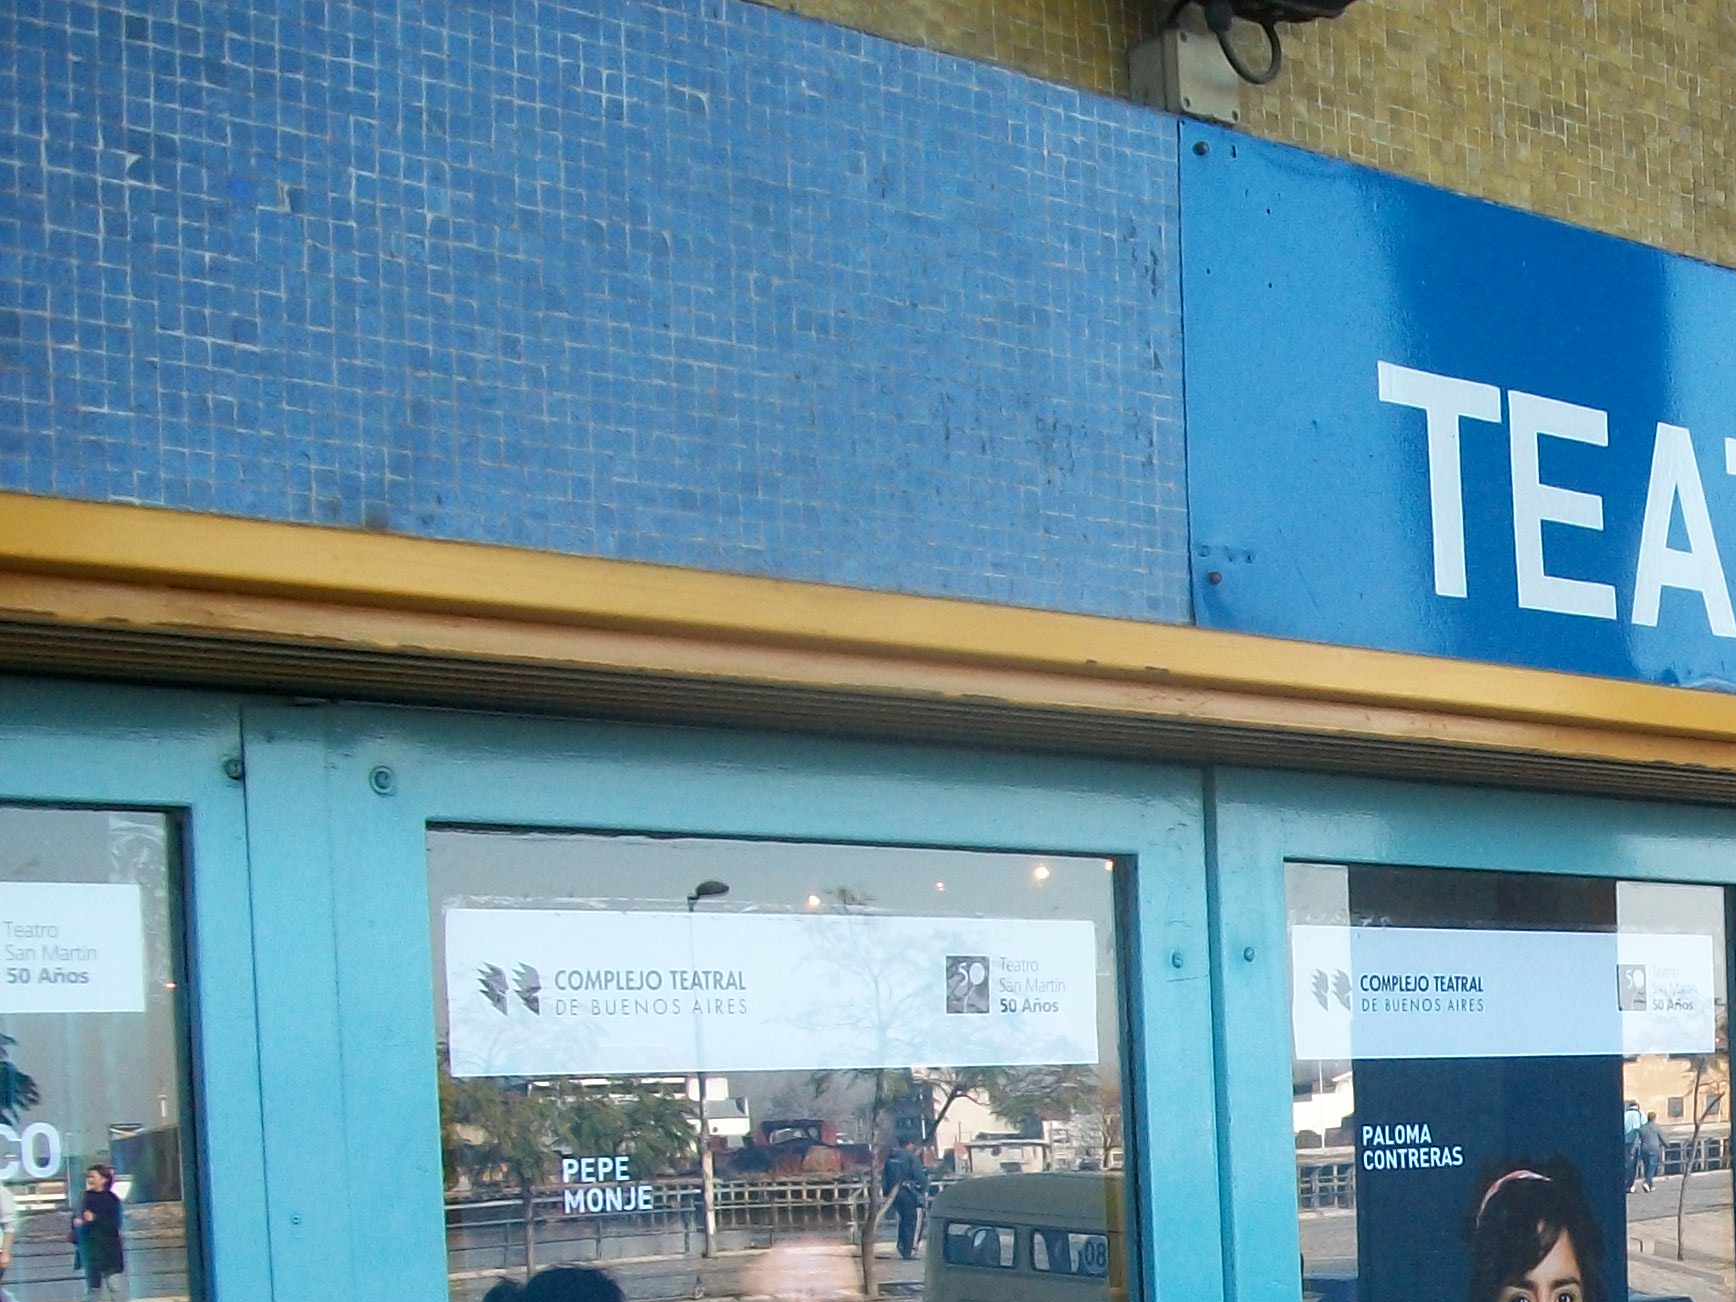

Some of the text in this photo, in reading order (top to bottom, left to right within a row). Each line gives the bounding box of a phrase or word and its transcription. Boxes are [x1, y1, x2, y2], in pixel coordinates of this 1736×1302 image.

[3, 920, 58, 938] Teatro
[5, 944, 36, 961] San
[999, 956, 1039, 973] Teatro
[6, 966, 90, 984] 50 Años
[554, 969, 747, 991] COMPLEJO TEATRAL
[1360, 974, 1484, 993] COMPLEJO TEATRAL
[999, 977, 1022, 993] San
[555, 998, 748, 1016] DE BUENOS AIRES
[1000, 997, 1060, 1013] 50 Años
[1361, 998, 1484, 1012] DE BUENOS AIRES
[1362, 1123, 1432, 1146] PALOMA
[1363, 1146, 1464, 1171] CONTRERAS
[562, 1156, 631, 1184] PEPE
[564, 1185, 654, 1214] MONJE
